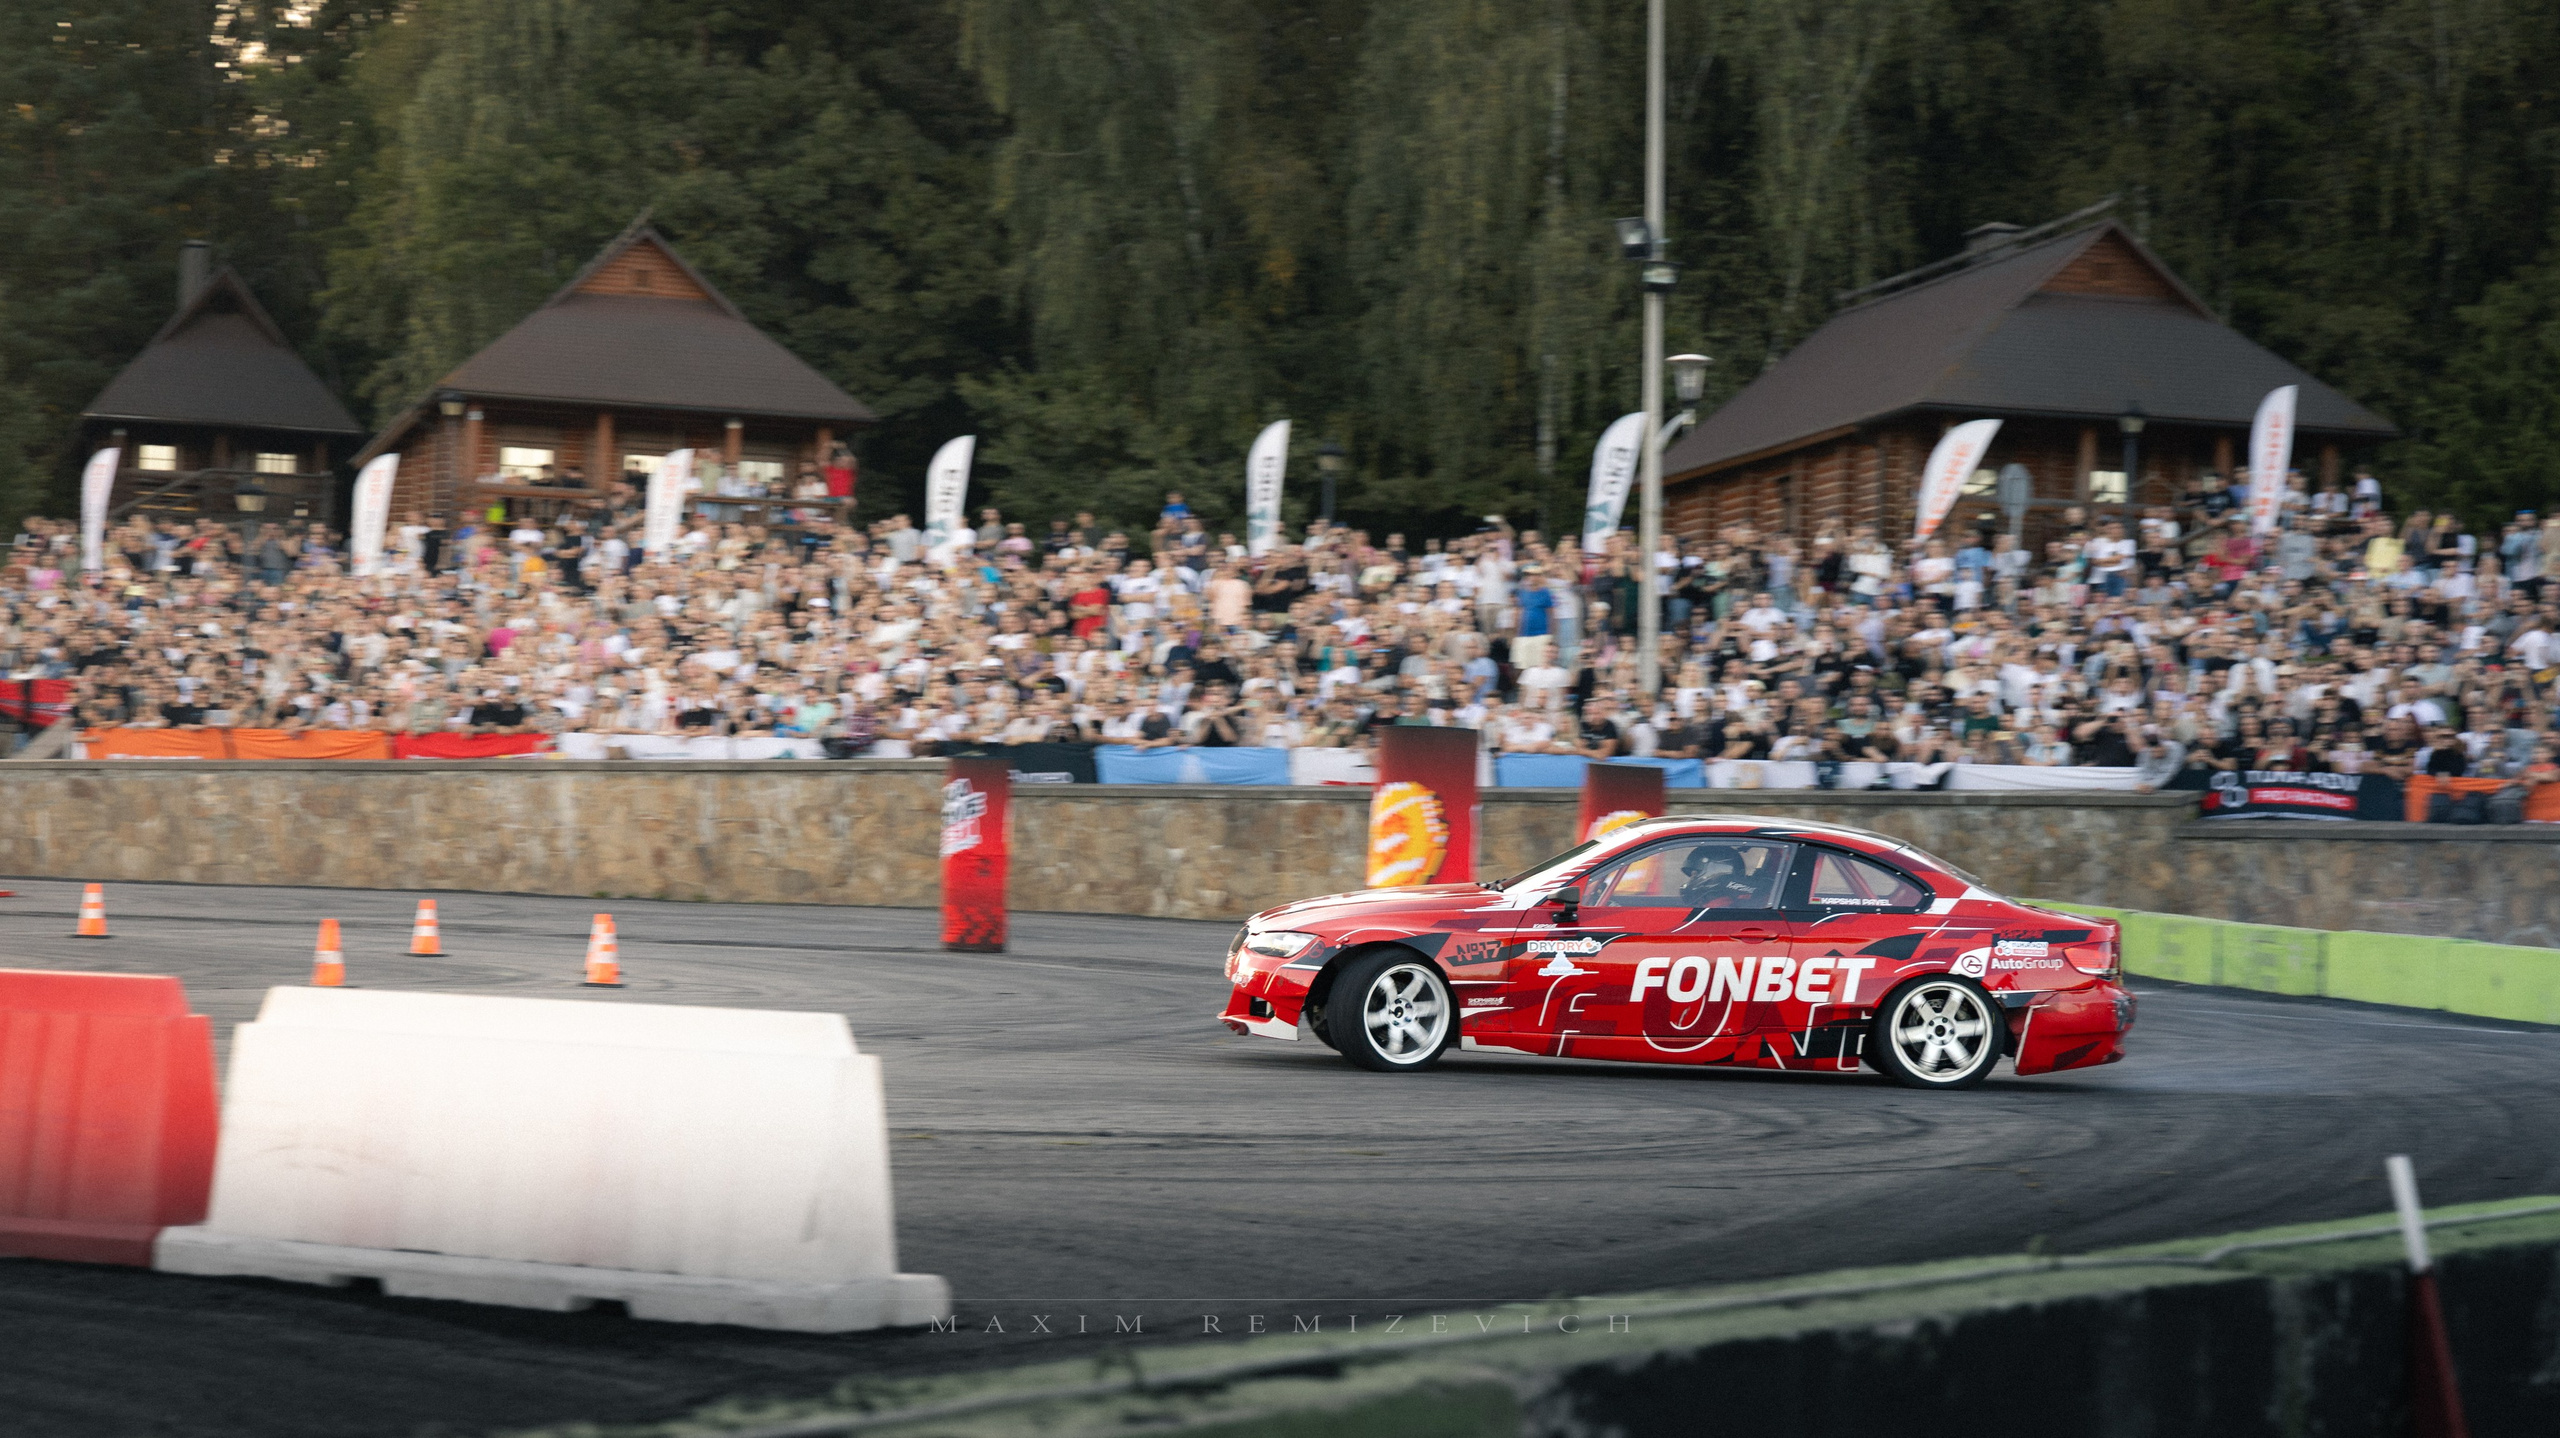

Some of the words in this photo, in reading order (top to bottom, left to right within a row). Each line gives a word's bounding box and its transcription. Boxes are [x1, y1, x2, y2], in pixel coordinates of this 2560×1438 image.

[1862, 898, 1893, 907] PAVEL
[1529, 940, 1583, 952] DRYDRY
[1991, 957, 2065, 971] AutoGroup
[1629, 955, 1877, 1003] FONBET
